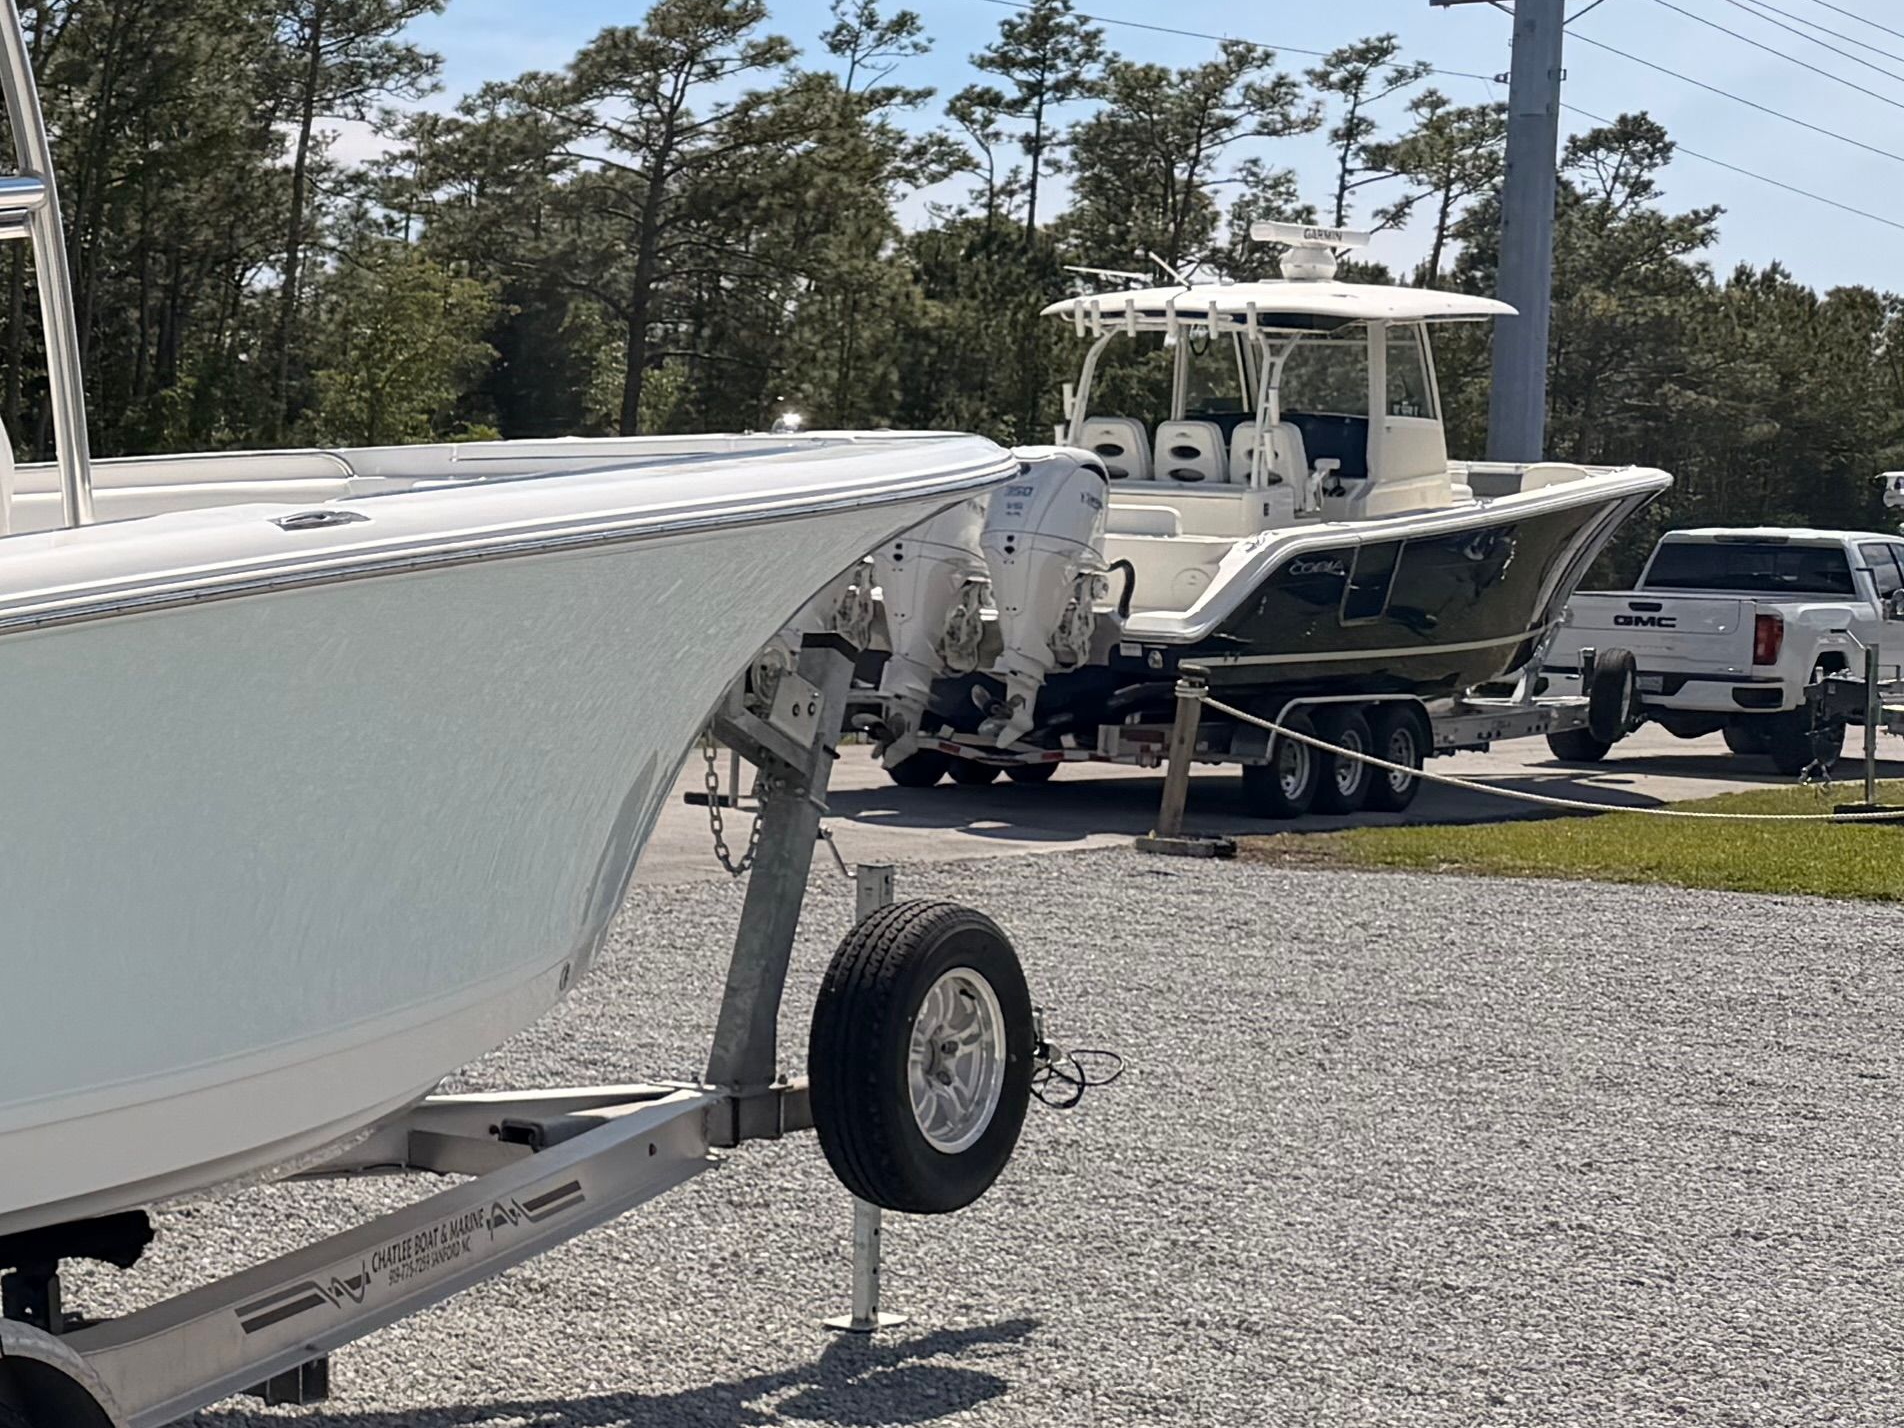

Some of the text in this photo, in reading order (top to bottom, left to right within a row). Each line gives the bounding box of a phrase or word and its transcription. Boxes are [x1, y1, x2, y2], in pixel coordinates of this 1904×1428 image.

[1303, 227, 1343, 241] GARMIN
[1613, 614, 1678, 628] GMC
[372, 1207, 484, 1273] CHATLEE BOAT & MARINE
